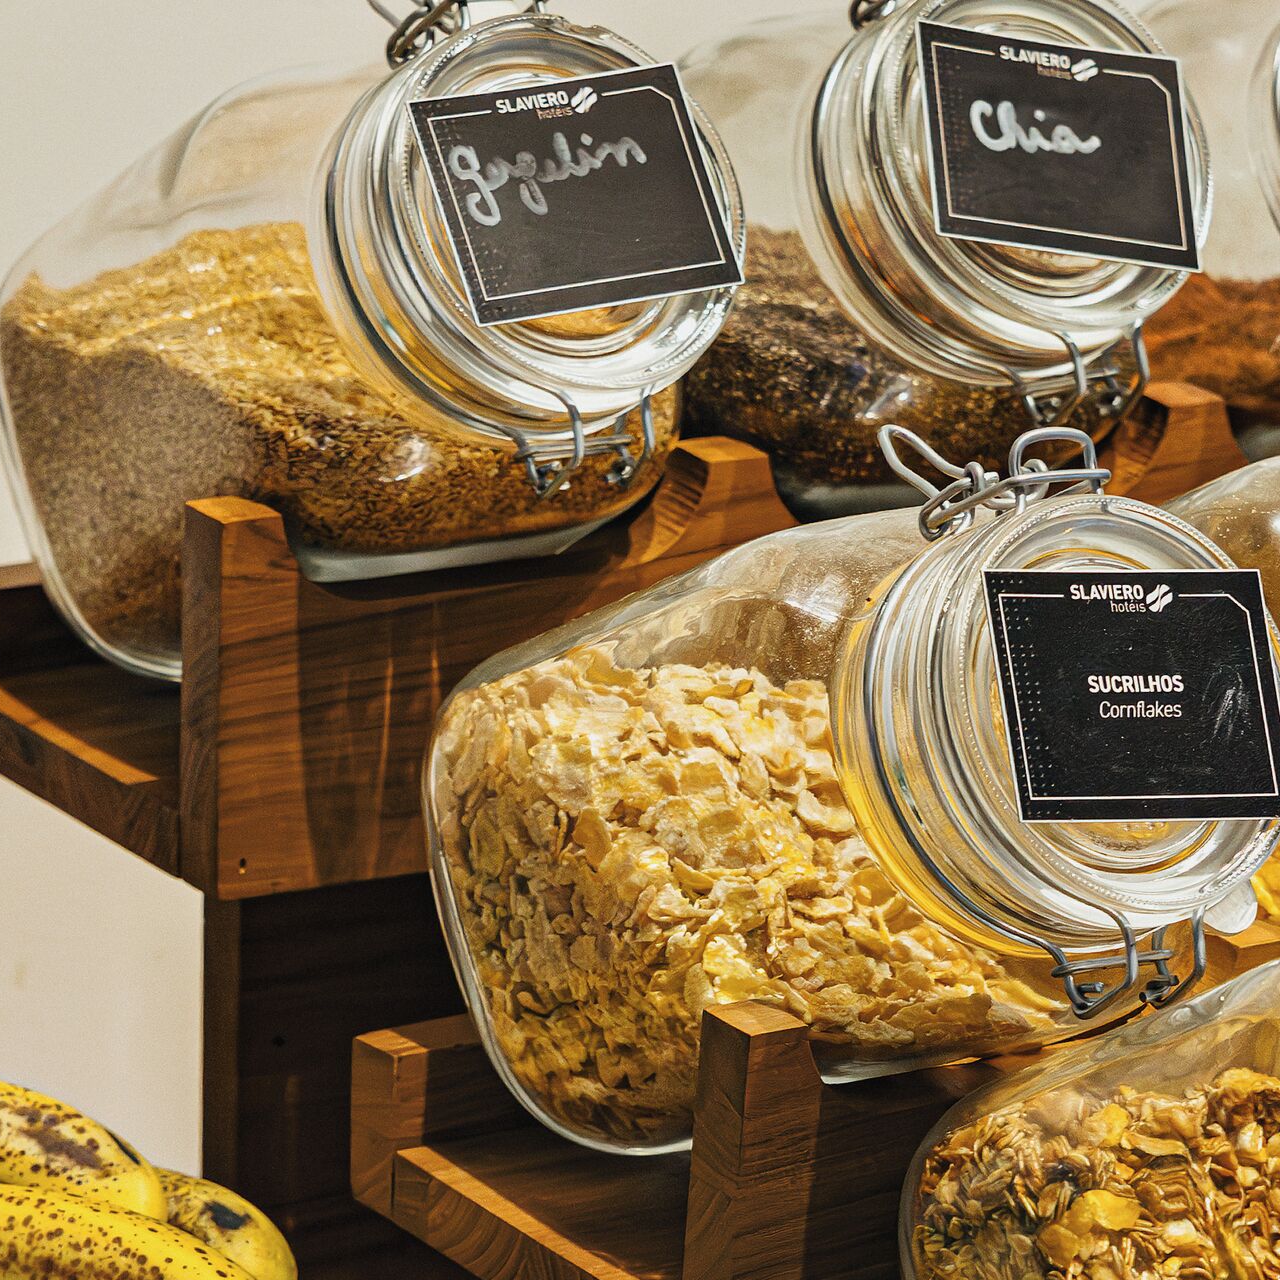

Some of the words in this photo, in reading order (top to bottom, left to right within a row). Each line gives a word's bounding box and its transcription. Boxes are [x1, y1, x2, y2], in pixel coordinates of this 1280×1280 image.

[999, 45, 1071, 69] SLAVIERO
[495, 90, 569, 114] SLAVIERO
[969, 100, 1102, 154] Chia
[1069, 584, 1144, 601] SLAVIERO
[1110, 600, 1147, 613] hotéis
[1087, 675, 1184, 693] SUCRILHOS
[1099, 700, 1182, 719] Cornflakes
